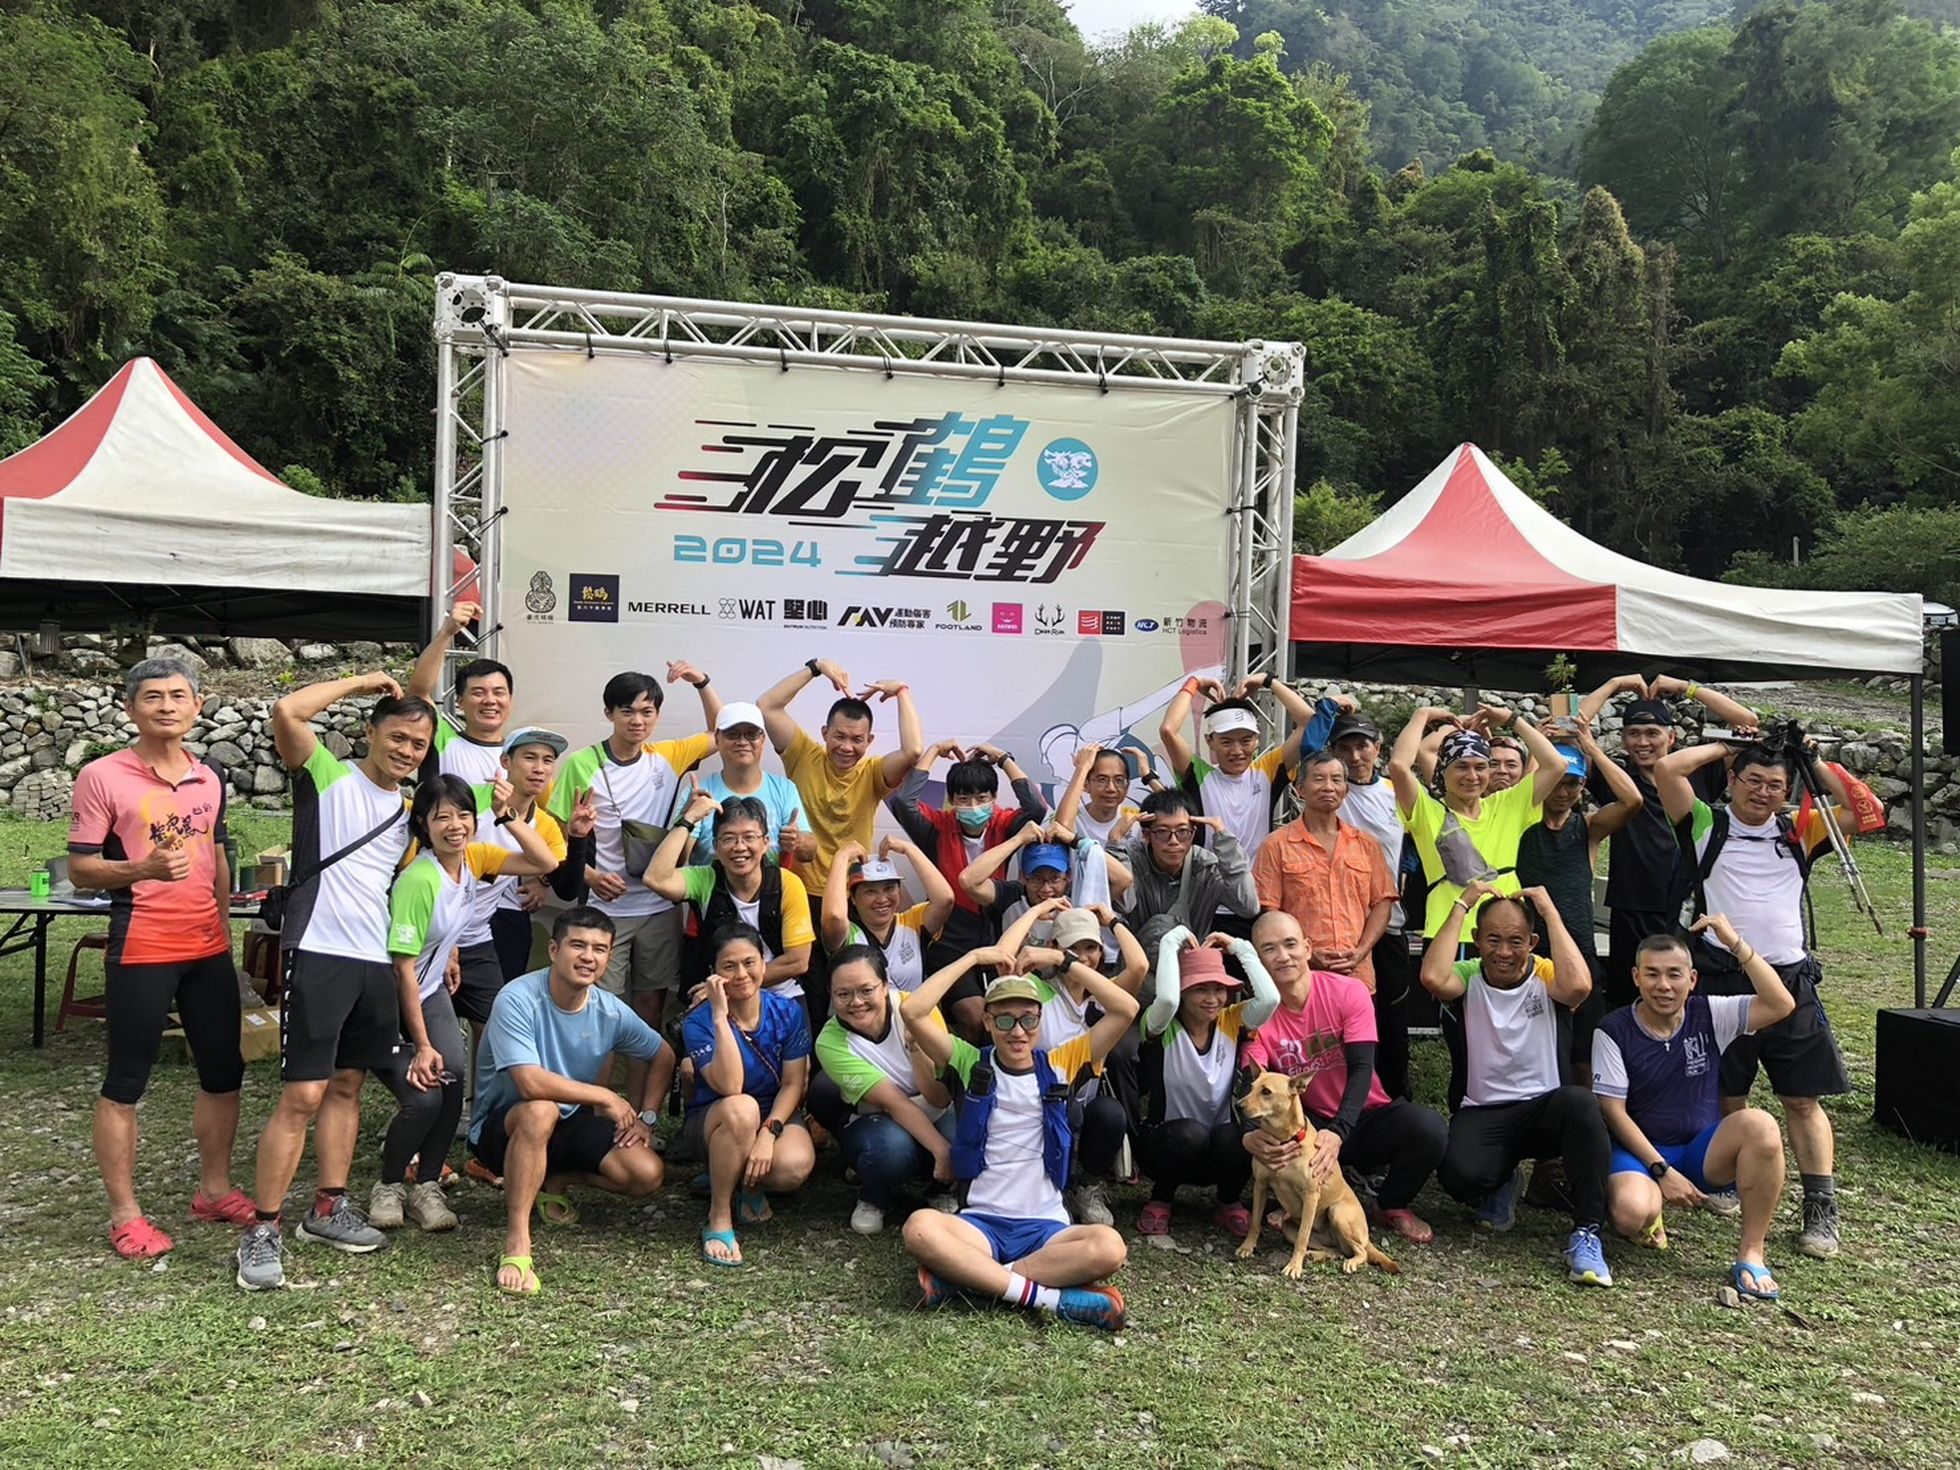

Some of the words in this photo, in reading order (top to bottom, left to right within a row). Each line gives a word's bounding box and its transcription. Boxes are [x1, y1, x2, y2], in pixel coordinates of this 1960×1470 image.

[656, 412, 1031, 518] 松鶴
[673, 534, 822, 567] 2024
[854, 514, 1106, 584] 越野
[628, 601, 711, 615] MERRELL
[739, 599, 776, 620] WAT
[894, 608, 931, 619] 運動傷害
[888, 619, 926, 629] 預防專家
[935, 623, 983, 631] FOOTLAND
[1163, 616, 1207, 628] 新竹物流
